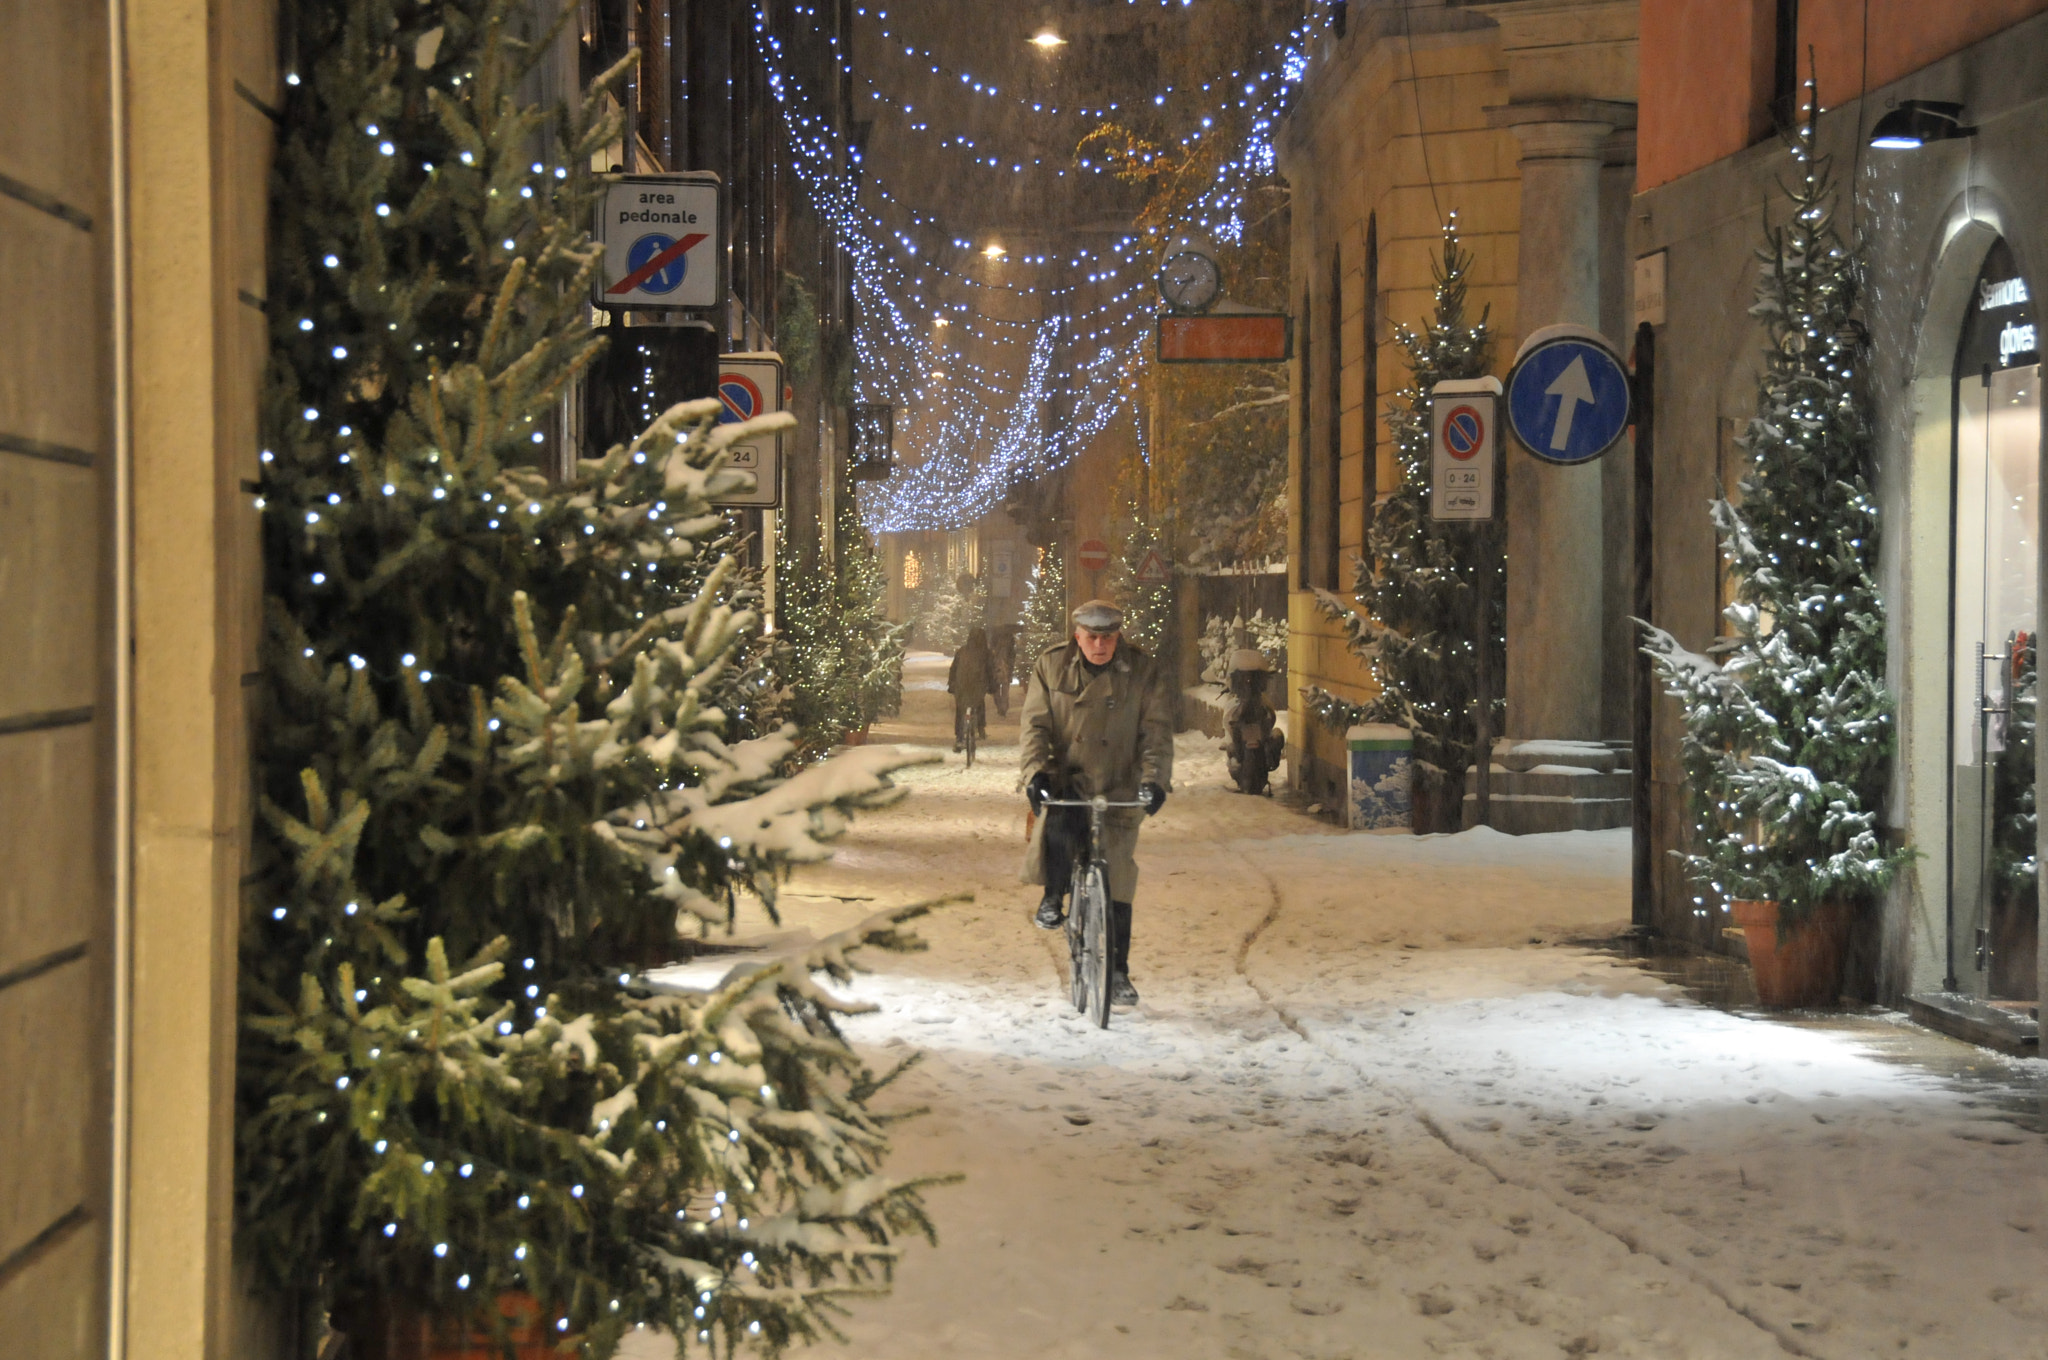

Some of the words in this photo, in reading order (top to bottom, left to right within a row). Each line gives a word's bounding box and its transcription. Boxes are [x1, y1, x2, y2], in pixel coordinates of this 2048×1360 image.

[639, 193, 675, 204] area
[619, 209, 697, 224] pedonale
[2000, 321, 2035, 363] gloves
[733, 451, 751, 463] 24
[1463, 473, 1476, 483] 24
